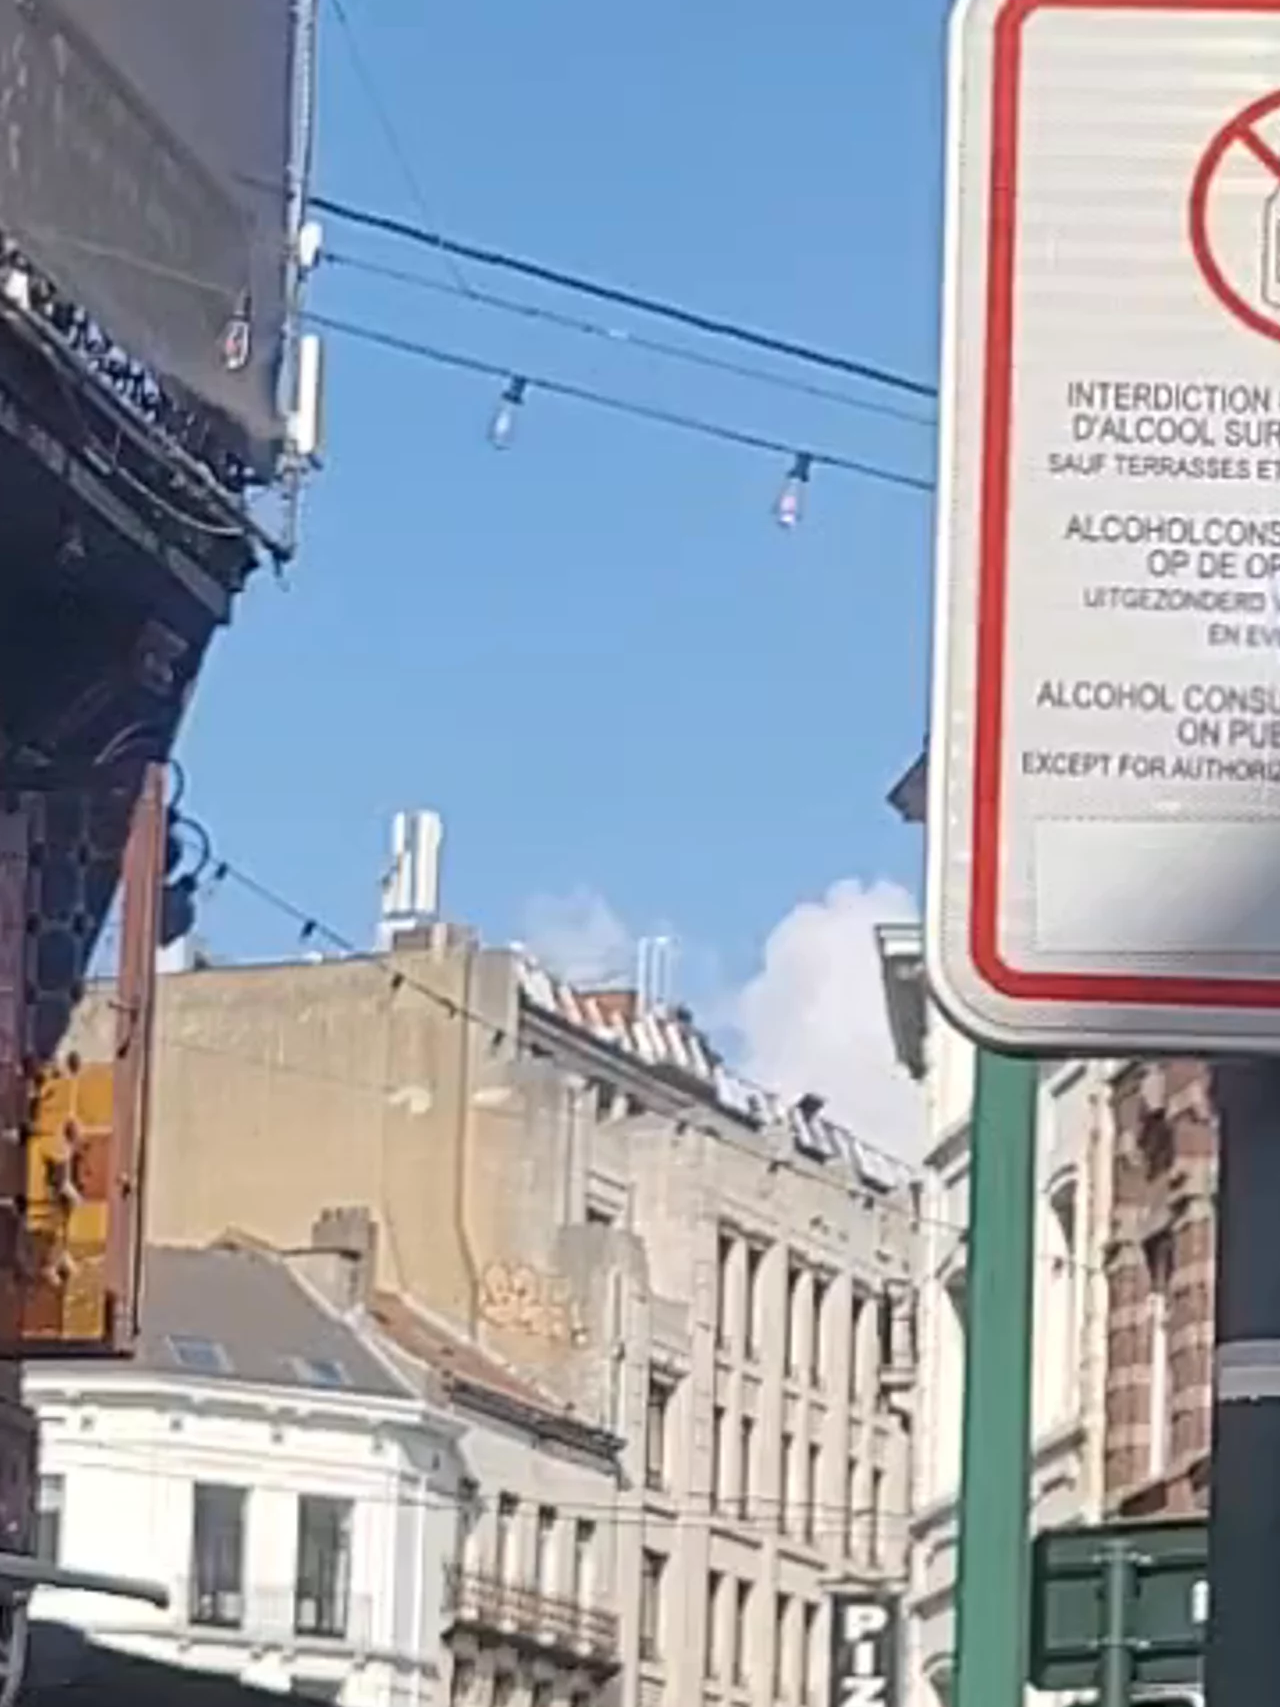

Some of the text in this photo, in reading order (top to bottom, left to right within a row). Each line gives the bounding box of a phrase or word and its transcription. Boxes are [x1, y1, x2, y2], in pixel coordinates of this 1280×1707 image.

[1067, 381, 1270, 414] INTERDICTION
[1073, 413, 1216, 446] D'ALCOOL
[1048, 453, 1107, 475] SAUF
[1115, 455, 1251, 480] TERRASSES
[1147, 549, 1190, 578] OP
[1197, 551, 1237, 580] DE
[1082, 587, 1266, 614] UITGEZONDERD
[1208, 623, 1240, 647] EN
[1036, 679, 1175, 713] ALCOHOL
[1177, 718, 1221, 747] ON
[1021, 750, 1112, 777] EXCEPT
[1118, 752, 1166, 779] FOR
